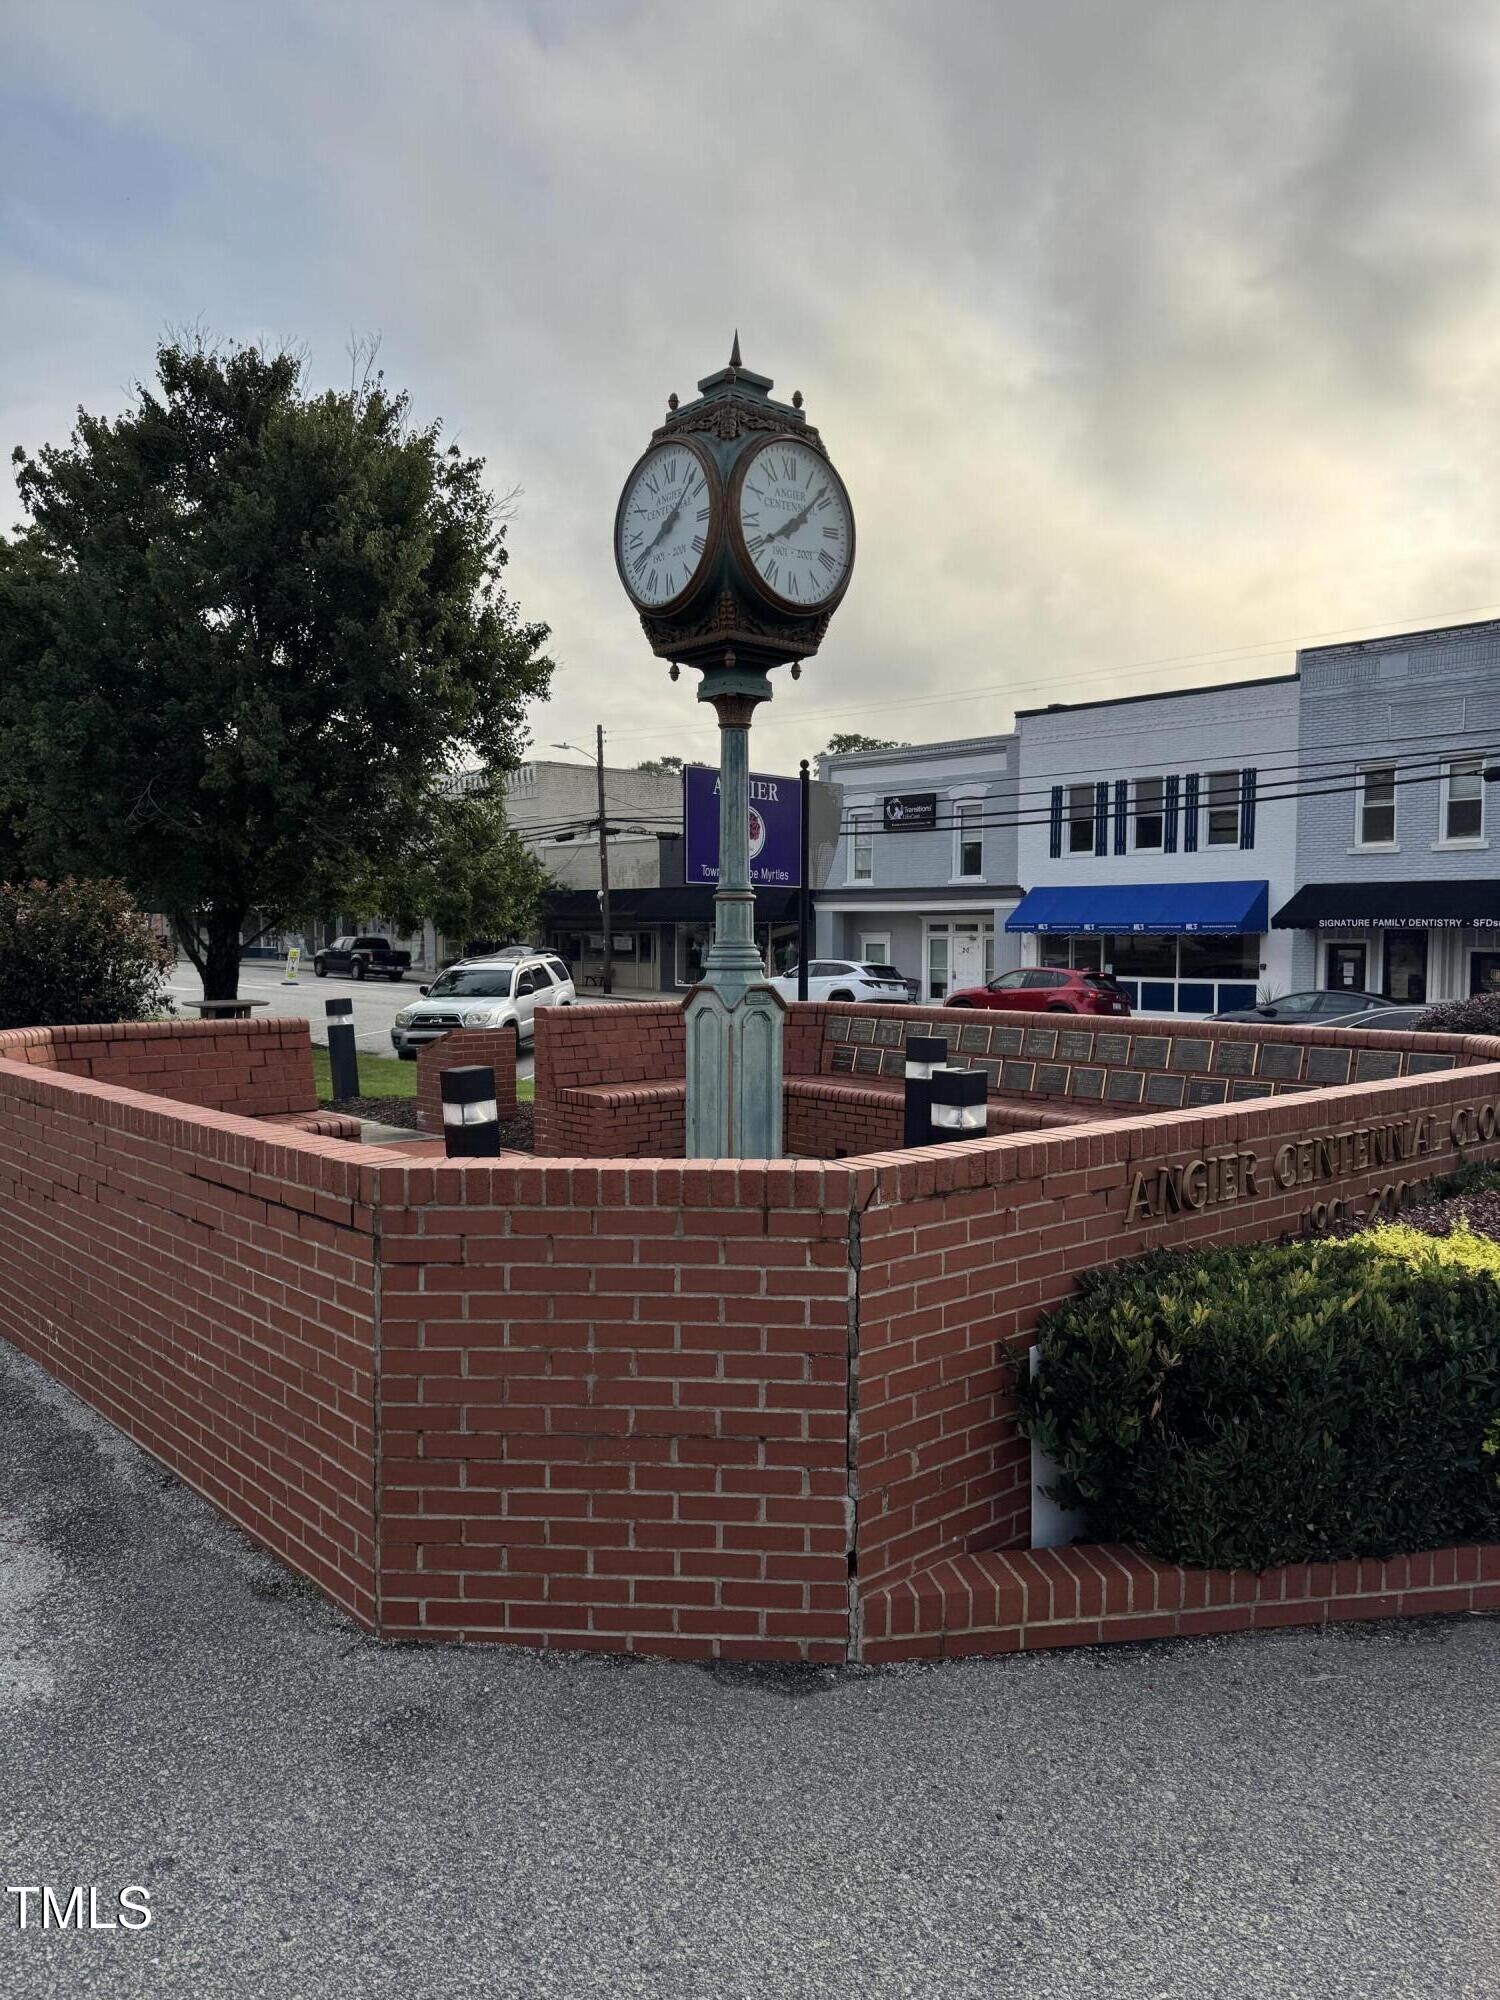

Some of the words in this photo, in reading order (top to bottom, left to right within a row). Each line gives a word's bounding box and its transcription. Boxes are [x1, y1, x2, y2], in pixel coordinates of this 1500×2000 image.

[775, 487, 806, 501] ANGIER
[647, 498, 693, 521] CENTENAL
[763, 496, 819, 516] CENTENN
[712, 776, 780, 802] AIER
[761, 867, 789, 883] Myrtles
[1318, 919, 1370, 928] SIGNATURE
[1372, 918, 1407, 928] FAMILY
[1408, 918, 1462, 928] DENTISTRY
[1122, 1150, 1261, 1224] ANGIER
[1273, 1113, 1443, 1189] CENTENNIAL
